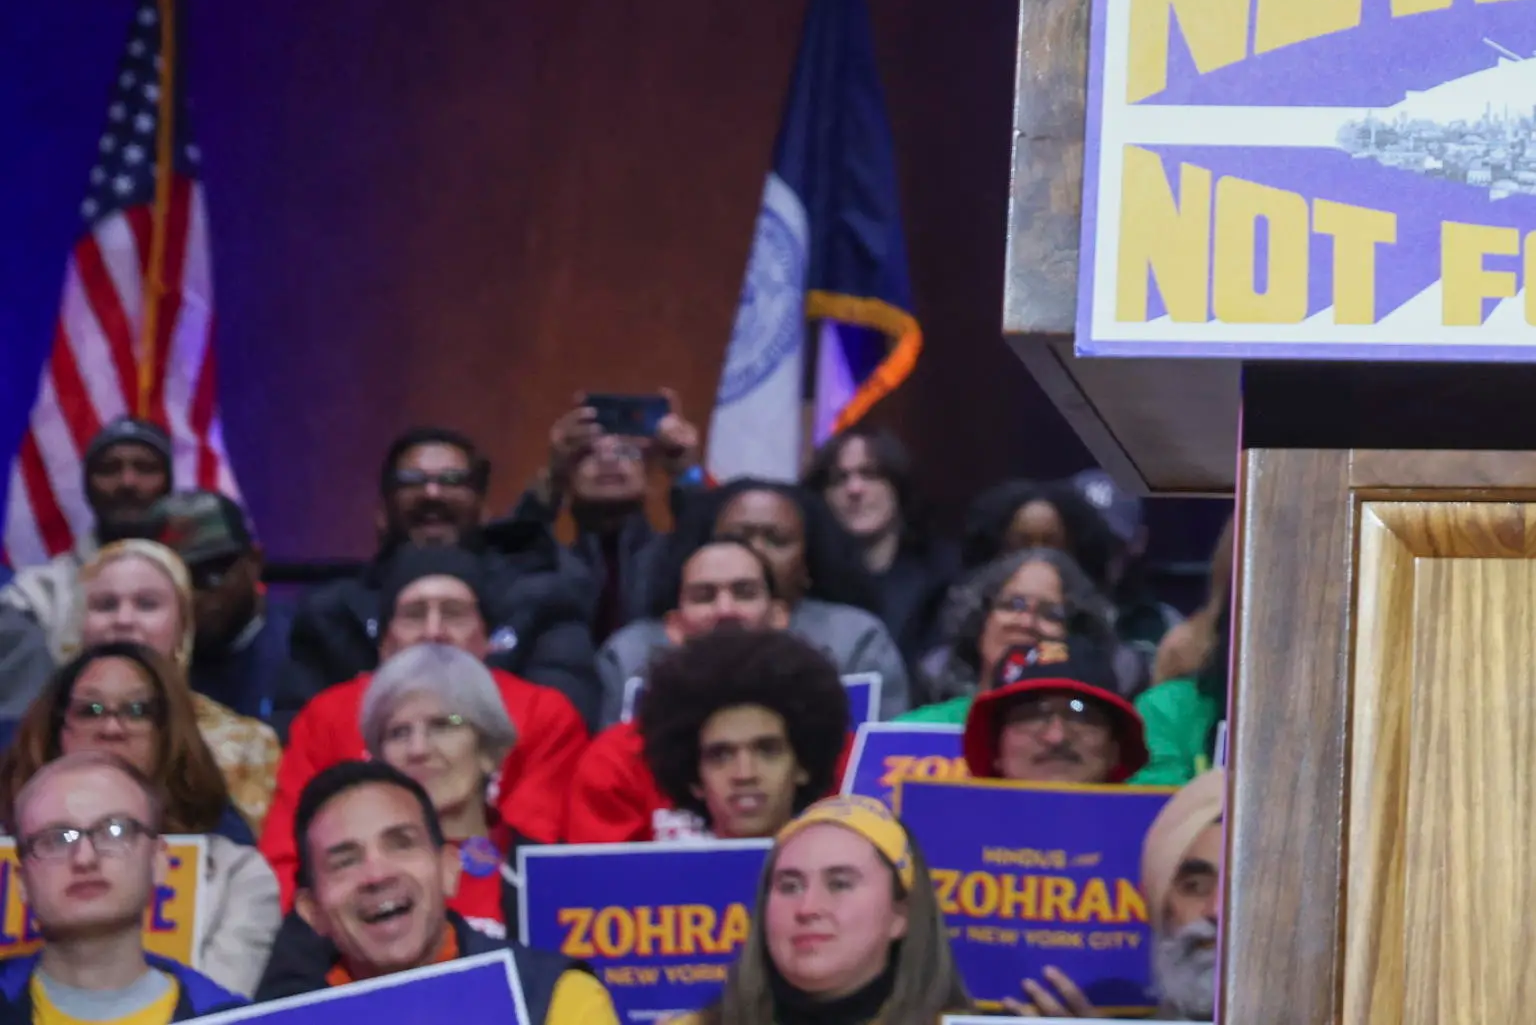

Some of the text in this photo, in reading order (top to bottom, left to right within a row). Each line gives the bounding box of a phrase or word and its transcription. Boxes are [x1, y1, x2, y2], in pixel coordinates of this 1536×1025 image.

[1115, 145, 1396, 324] NOT
[558, 902, 751, 958] ZOHRA
[966, 927, 1019, 946] NEW
[1025, 930, 1085, 950] YORK
[1088, 931, 1142, 951] CITY
[604, 965, 659, 985] NEW
